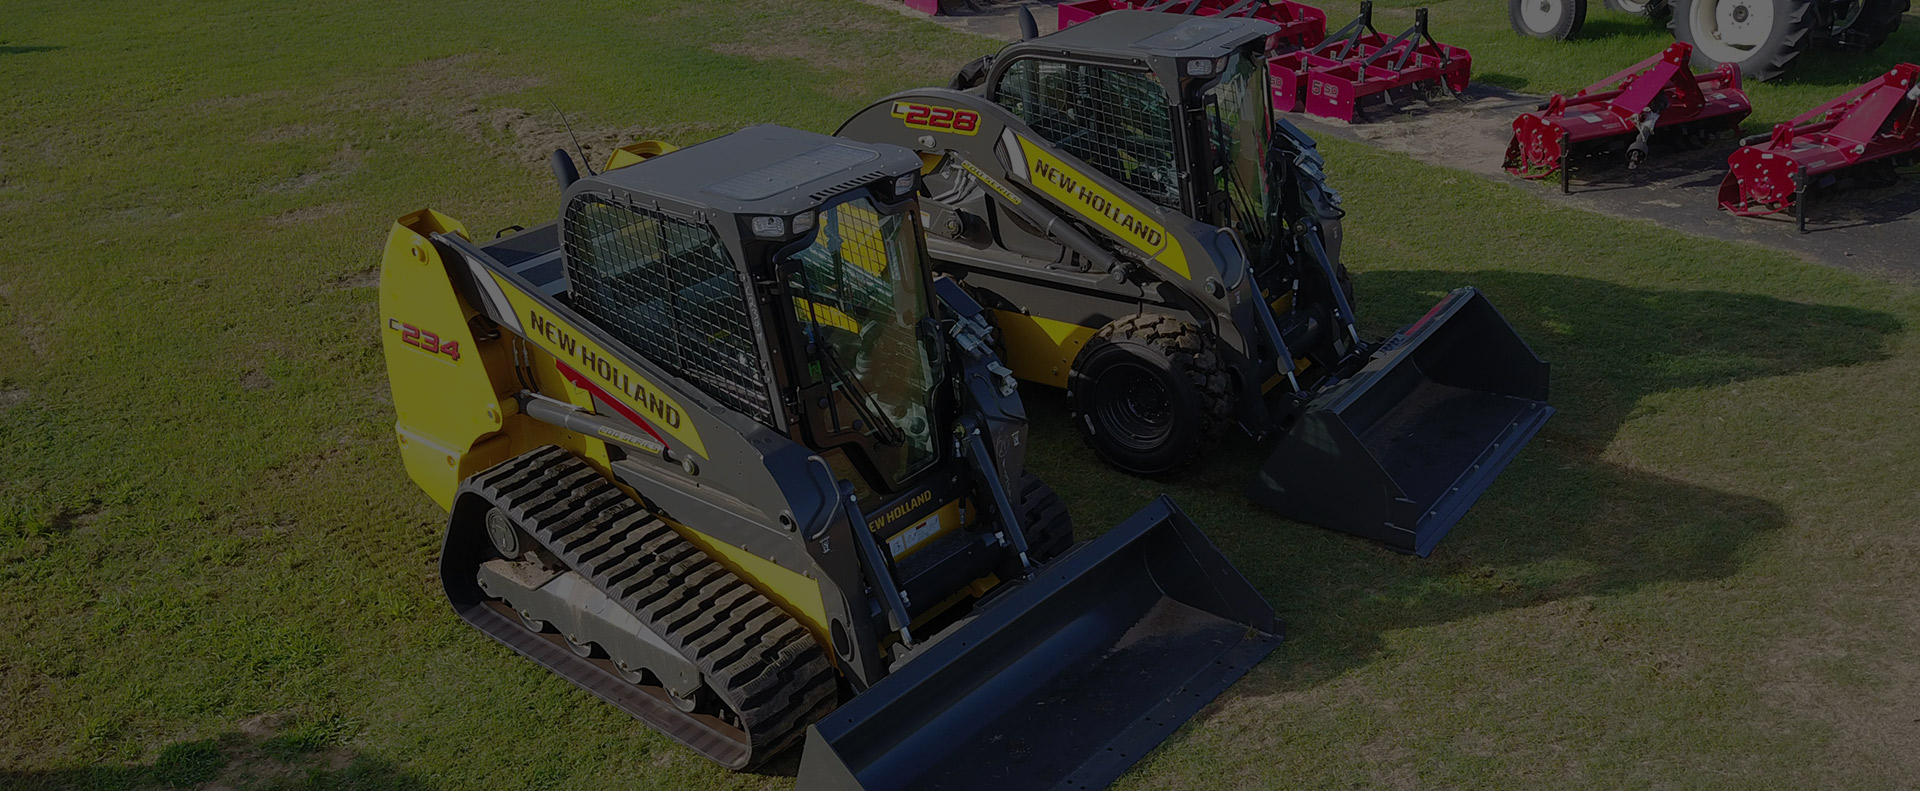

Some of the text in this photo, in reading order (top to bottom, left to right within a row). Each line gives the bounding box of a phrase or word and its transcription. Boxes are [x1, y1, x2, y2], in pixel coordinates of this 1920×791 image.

[962, 161, 1020, 203] 200 SERIES
[1035, 159, 1162, 247] NEW HOLLAND
[530, 310, 681, 430] NEW HOLLAND
[599, 426, 659, 452] 200 SERIES
[868, 490, 933, 533] EW HOLLAND
